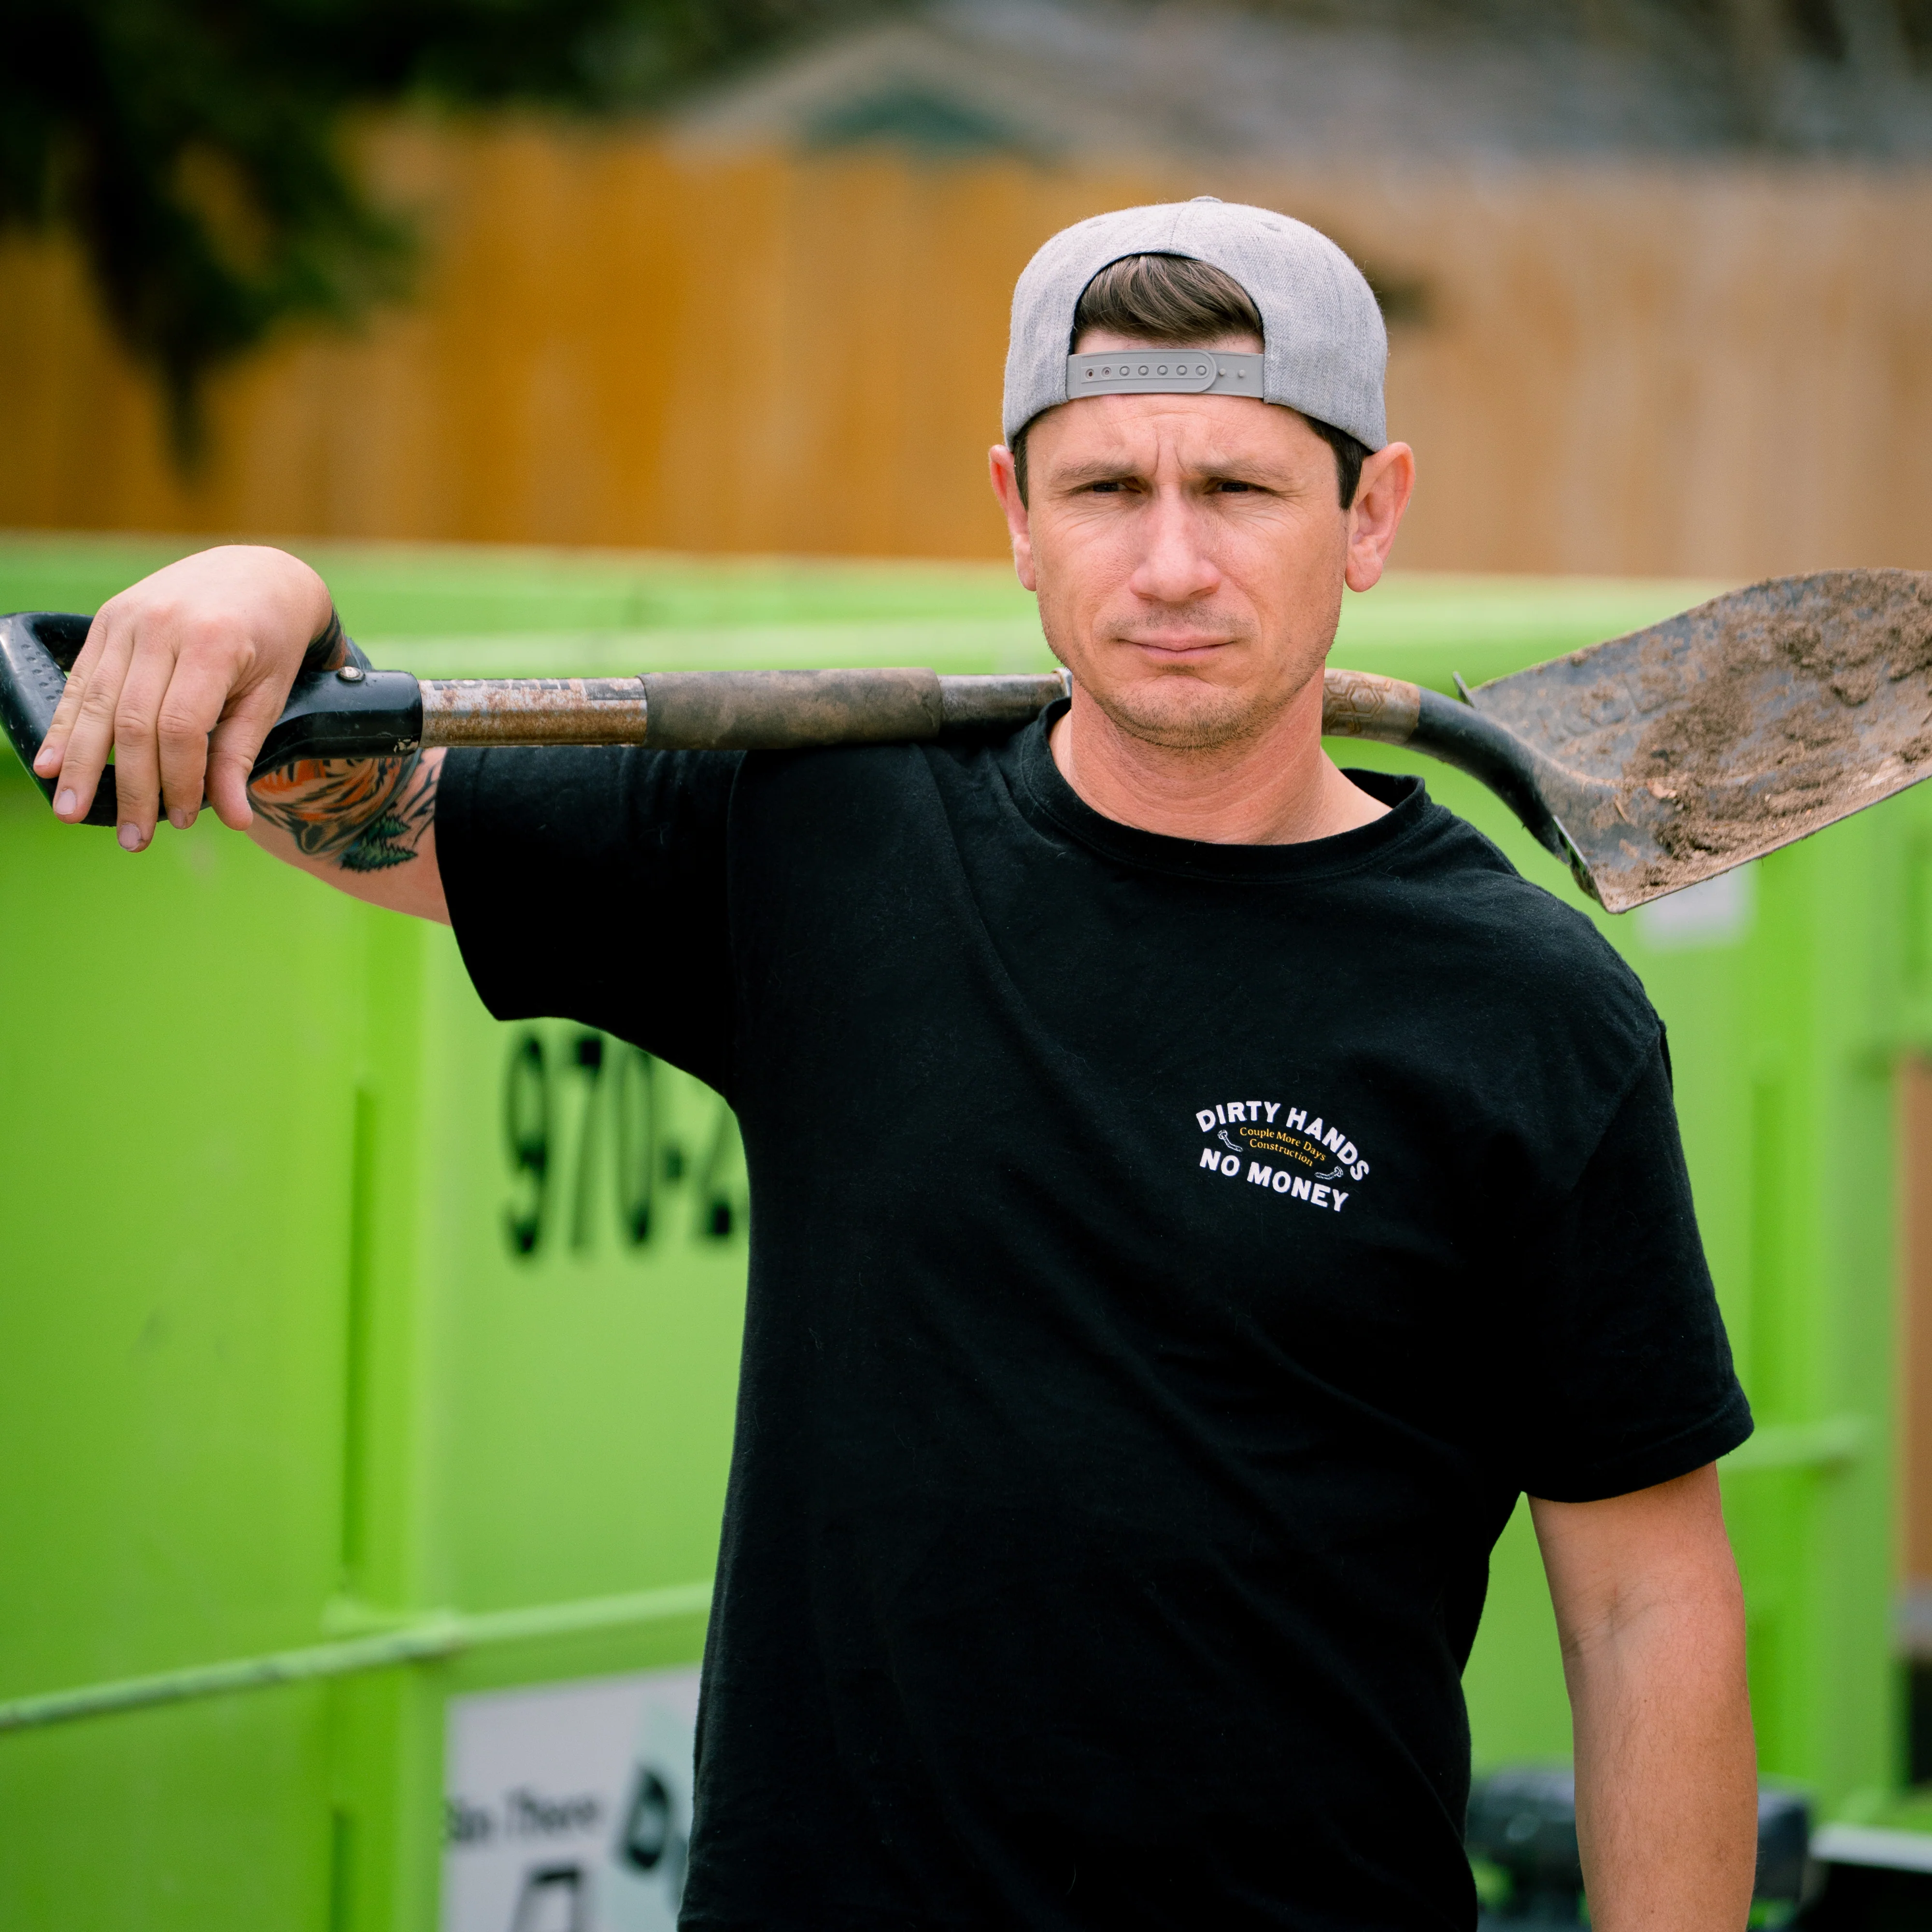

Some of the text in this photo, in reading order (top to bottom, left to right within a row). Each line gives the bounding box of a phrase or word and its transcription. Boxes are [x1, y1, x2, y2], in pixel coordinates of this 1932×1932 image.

[1195, 1101, 1370, 1181] DIRTY HANDS
[1240, 1127, 1326, 1161] Couple More Days
[1250, 1138, 1313, 1167] Construction
[1199, 1148, 1350, 1212] NO MONEY
